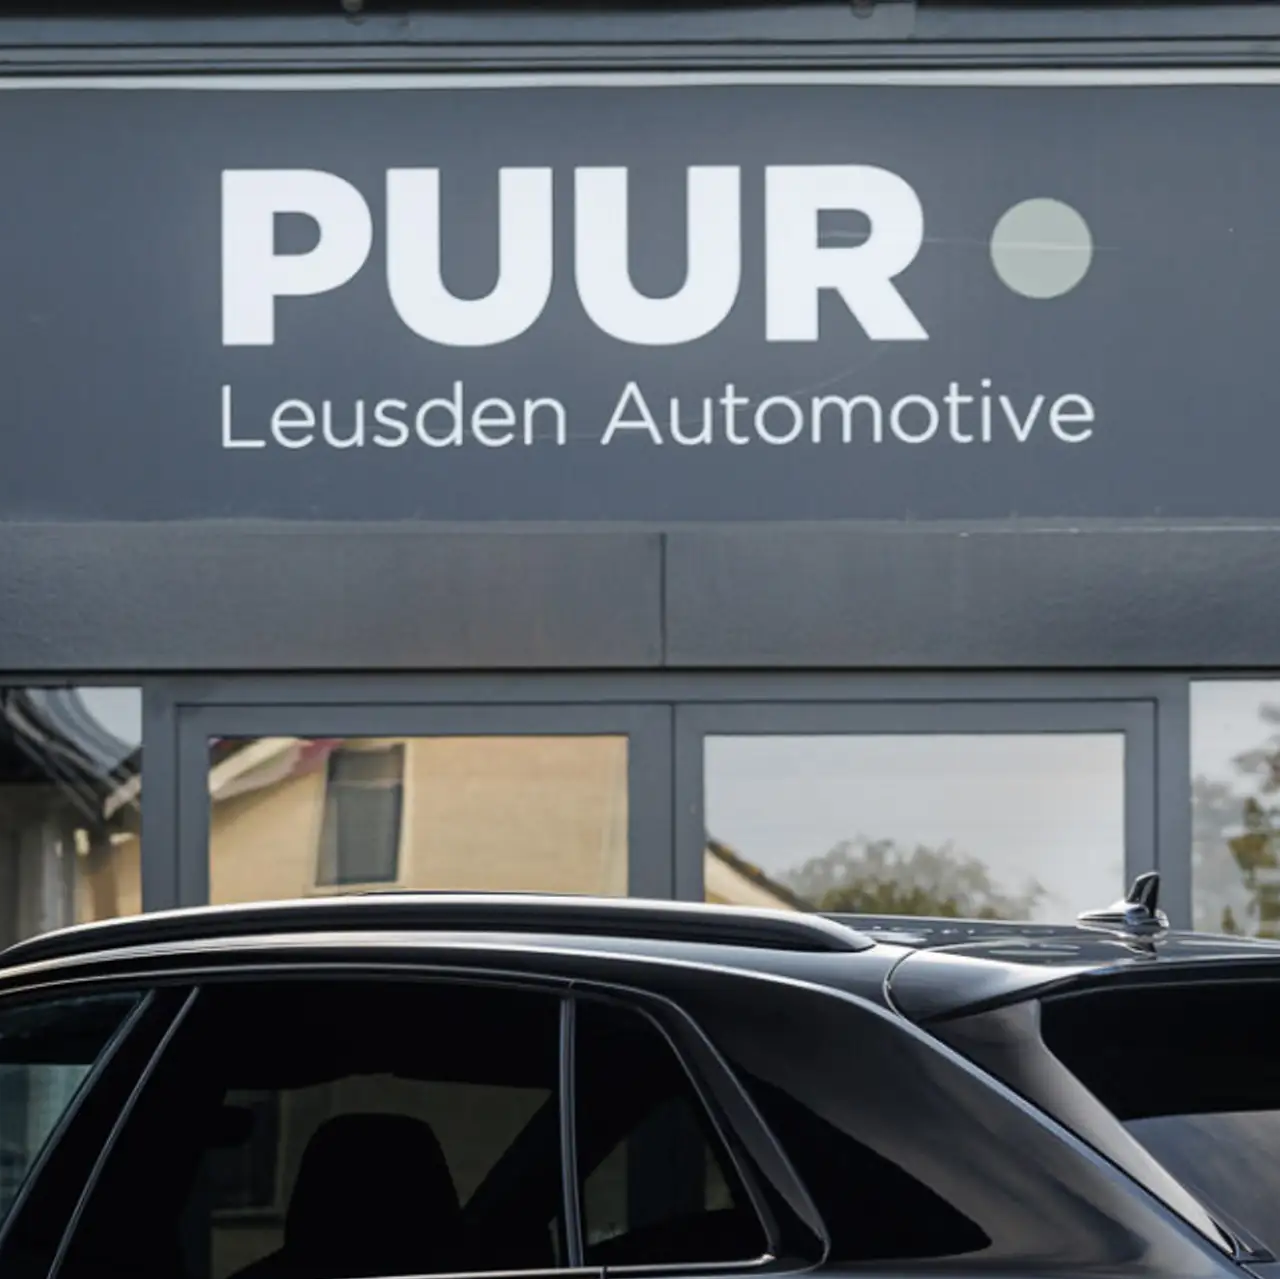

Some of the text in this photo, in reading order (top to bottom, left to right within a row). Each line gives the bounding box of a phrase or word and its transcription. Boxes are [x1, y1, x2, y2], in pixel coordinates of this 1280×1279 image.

[222, 165, 930, 347] PUUR
[222, 378, 1096, 449] Leusden Automotive
